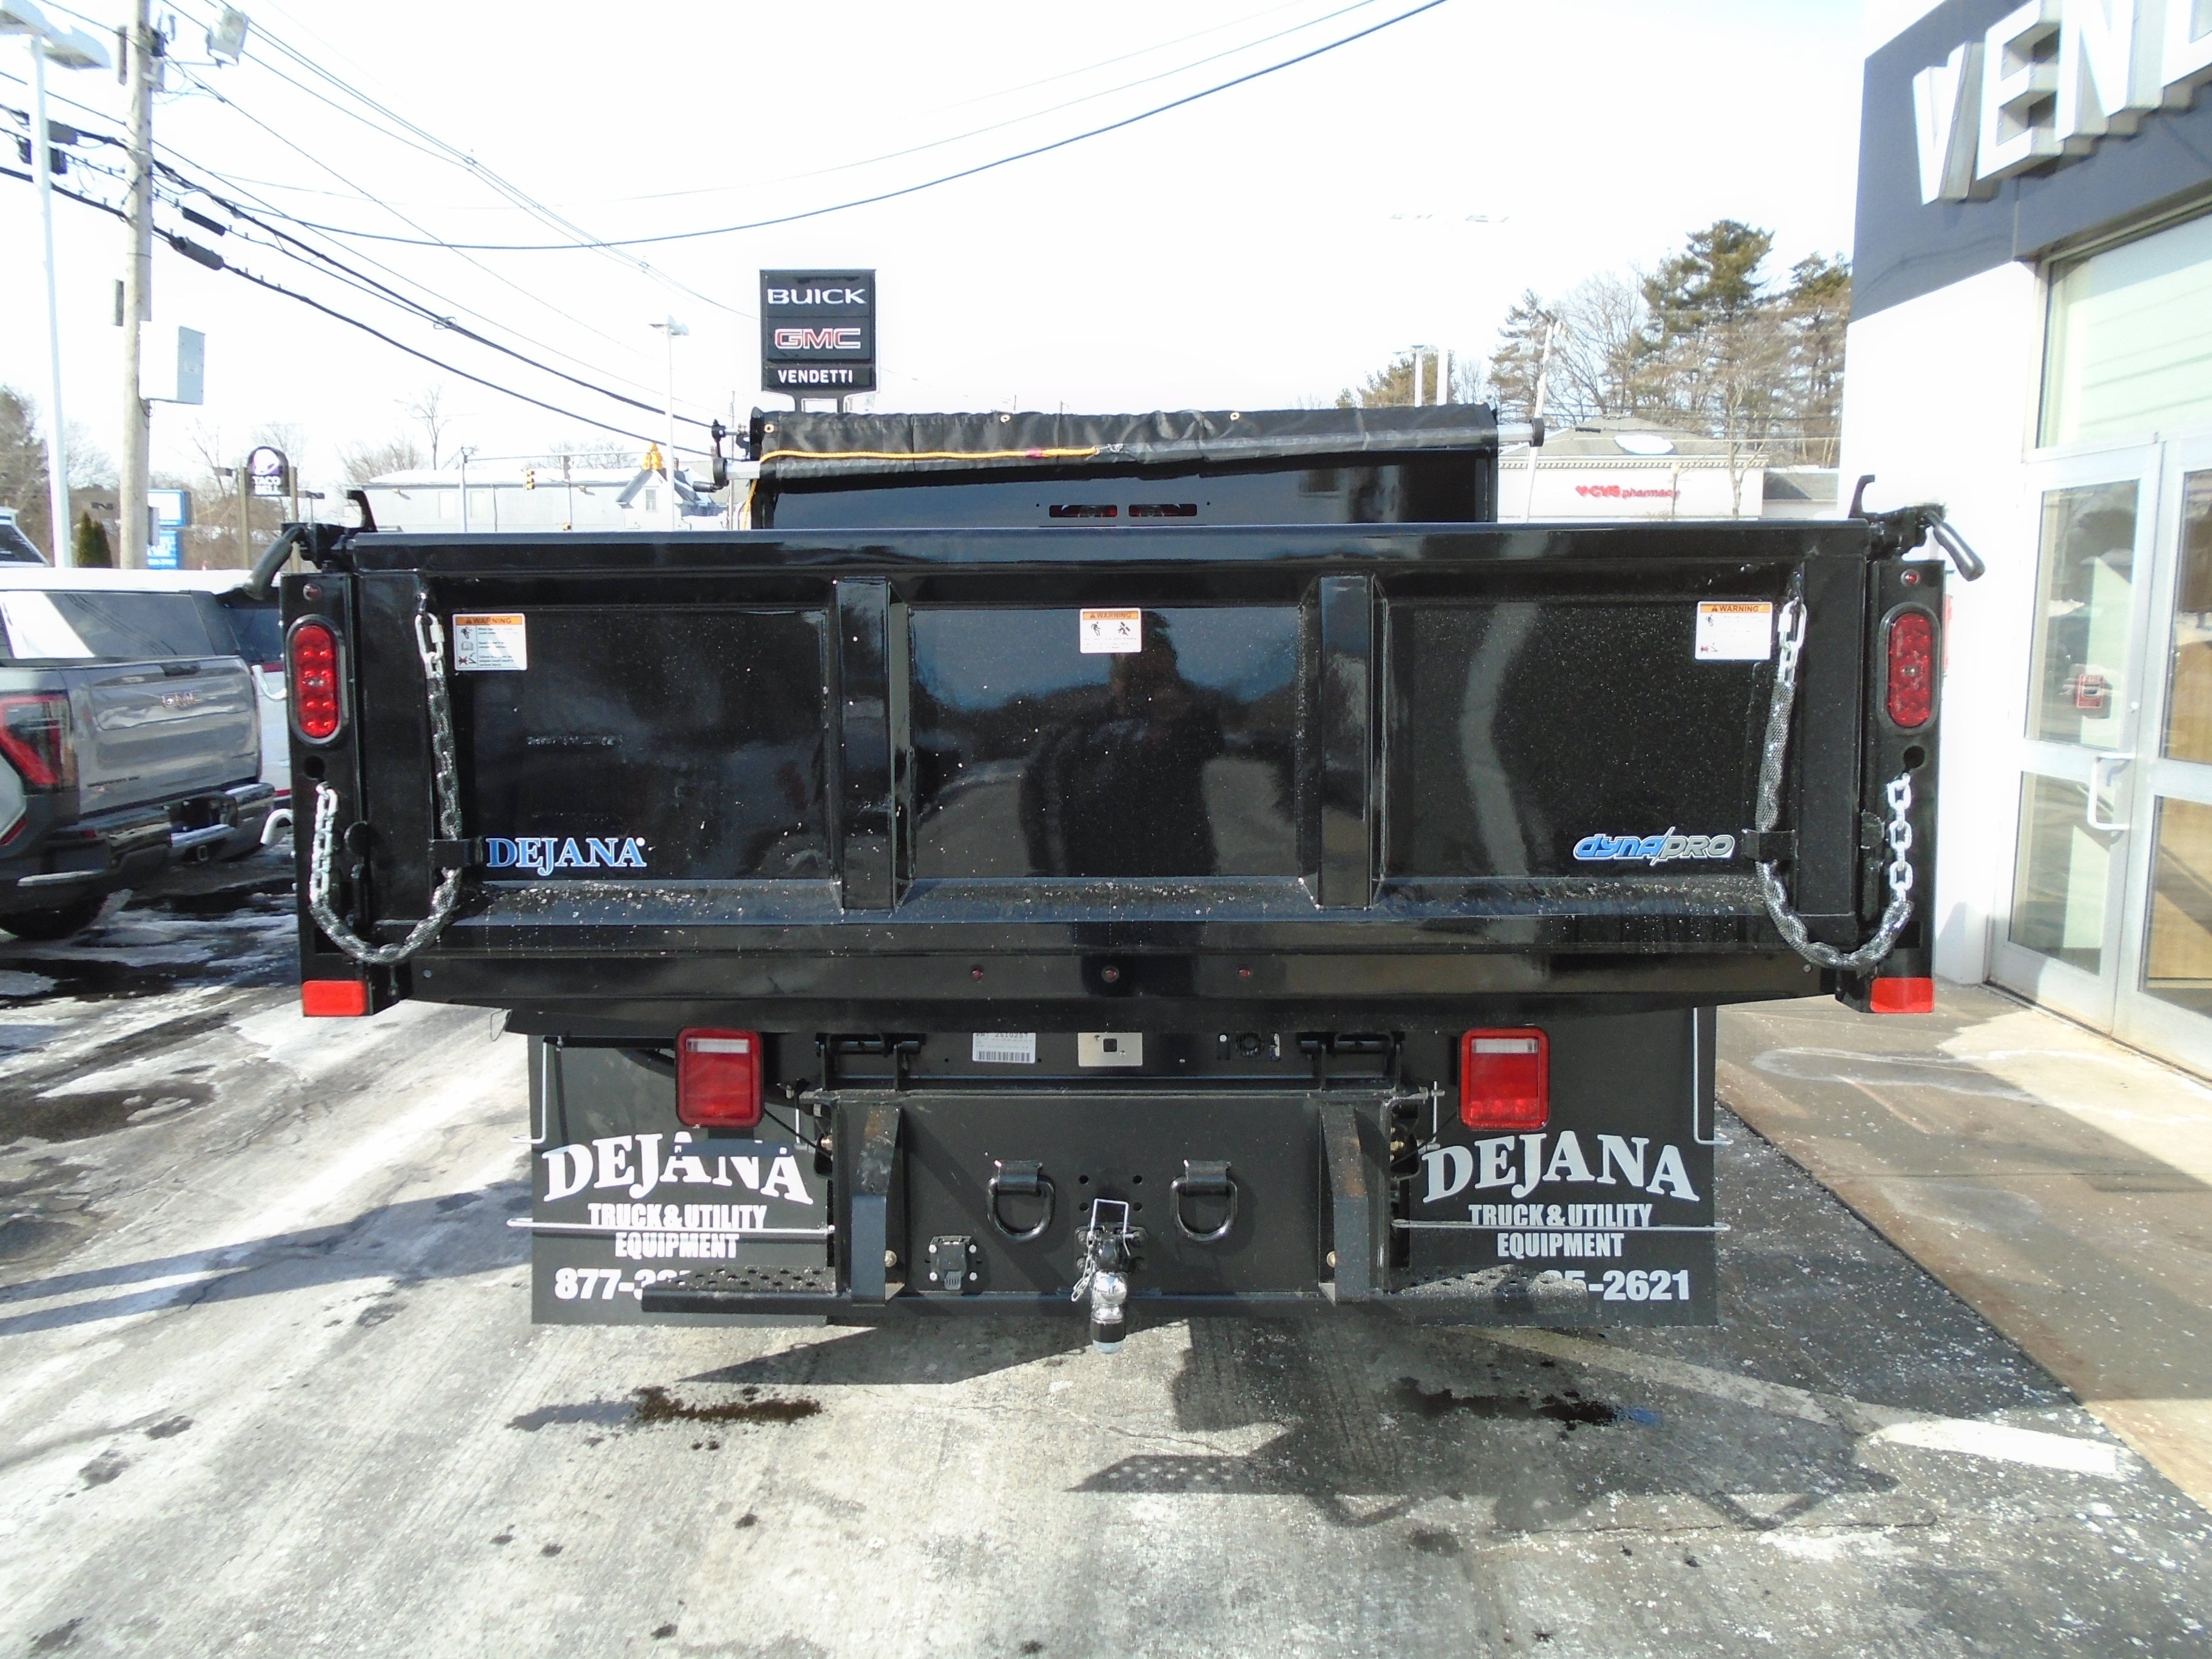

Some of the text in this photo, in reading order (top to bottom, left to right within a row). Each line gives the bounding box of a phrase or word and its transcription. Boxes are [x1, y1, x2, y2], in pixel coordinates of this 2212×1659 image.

[767, 288, 866, 304] BUICK
[774, 327, 861, 349] GMC
[777, 369, 853, 383] VENDETTI
[252, 475, 281, 486] TACO
[1589, 485, 1681, 500] CVS pharmacy
[485, 837, 647, 876] DEJANA
[1421, 1130, 1700, 1204] DEJANA
[615, 1232, 740, 1259] EQUIPMENT
[1496, 1232, 1624, 1259] EQUIPMENT
